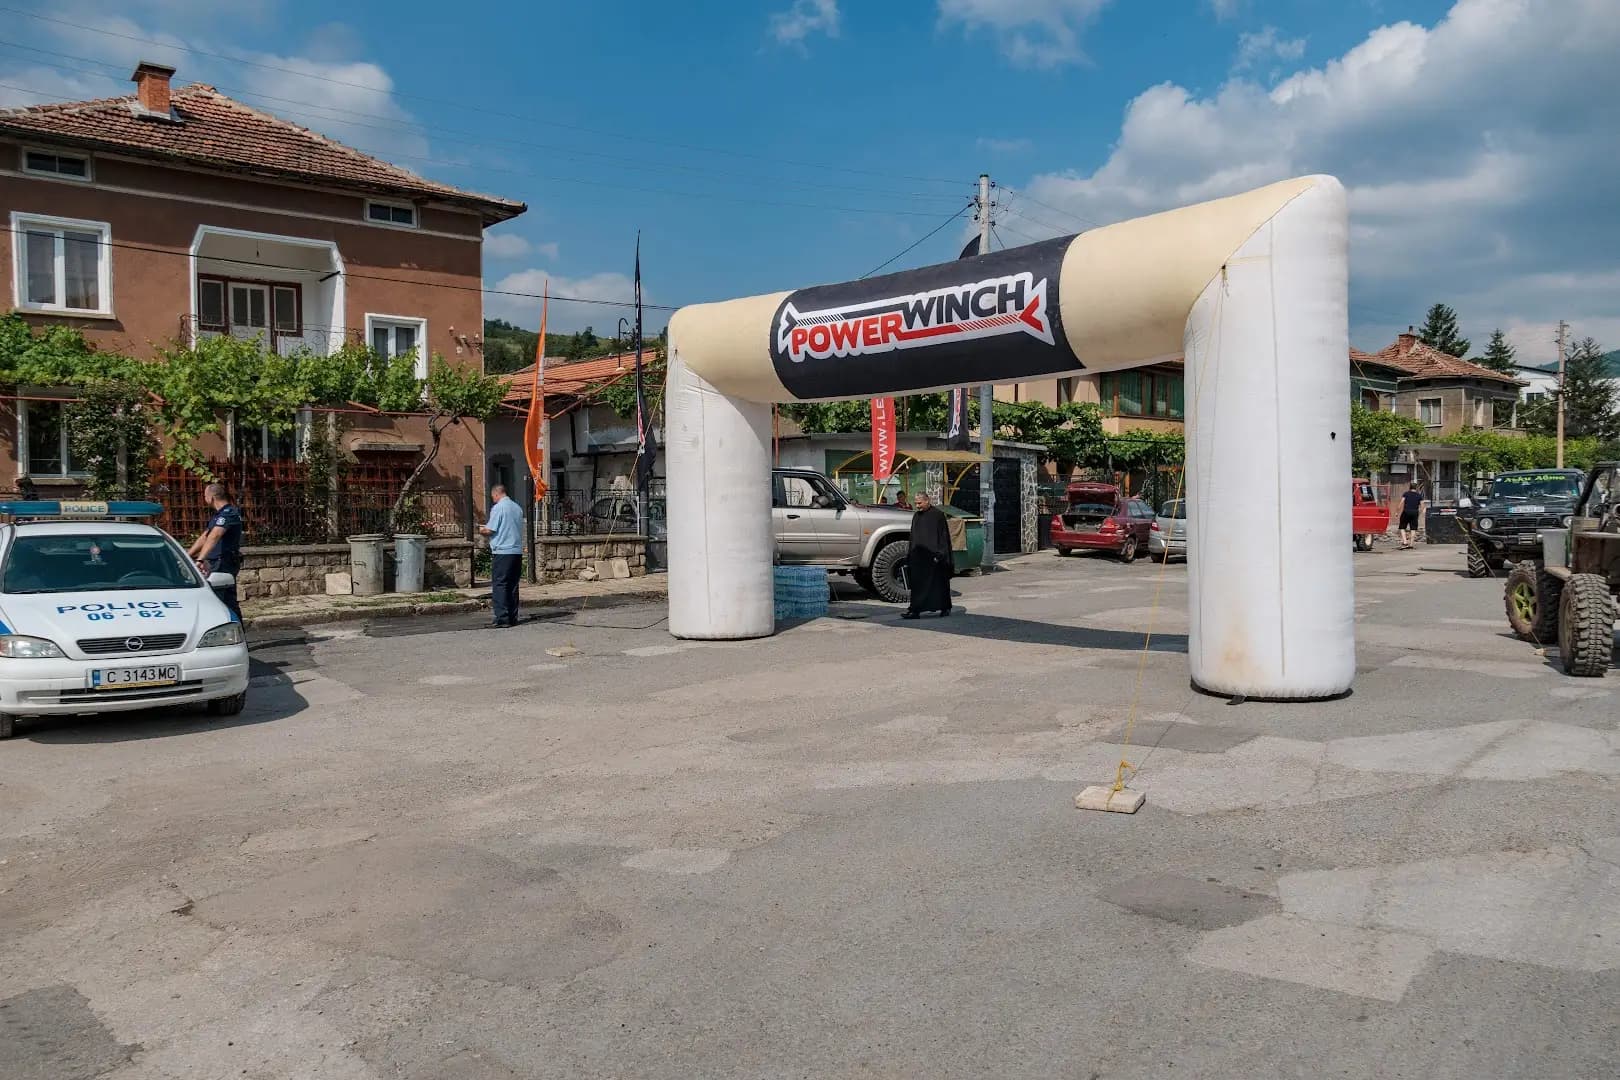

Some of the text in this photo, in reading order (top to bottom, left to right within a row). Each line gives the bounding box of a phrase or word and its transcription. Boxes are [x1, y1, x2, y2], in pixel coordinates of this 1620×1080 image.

[64, 505, 105, 513] POLICE
[56, 601, 183, 614] POLICE
[87, 612, 115, 621] 06
[138, 610, 166, 618] 62
[107, 671, 116, 683] C
